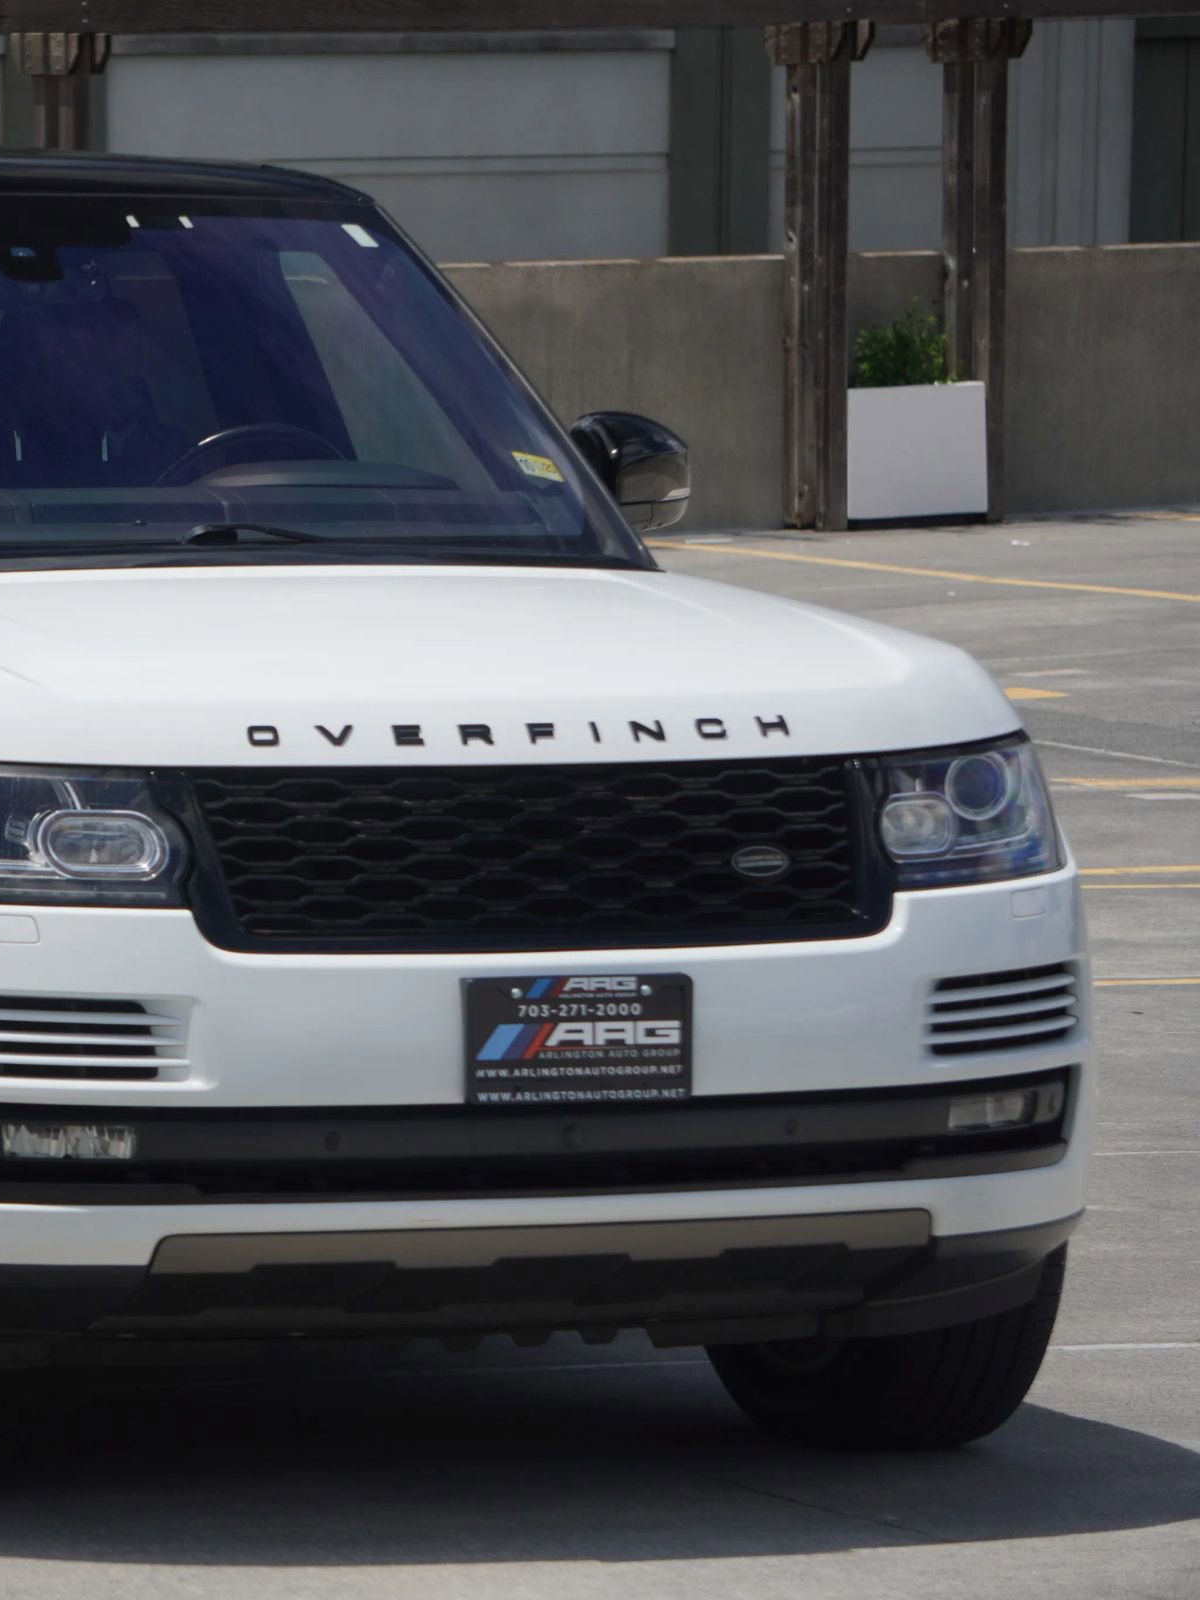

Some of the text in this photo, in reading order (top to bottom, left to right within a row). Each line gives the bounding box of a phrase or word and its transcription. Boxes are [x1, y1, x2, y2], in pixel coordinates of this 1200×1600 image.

[246, 715, 791, 748] OVERFINCH
[562, 976, 638, 991] AAG
[517, 1002, 642, 1018] 703-271-2000
[544, 1020, 681, 1047] AAG
[538, 1048, 681, 1059] ARLINGTON AUTO GROUP
[475, 1064, 683, 1078] WWW.ARLINGTONAUTOGROUP.NET
[477, 1088, 685, 1102] WWW.ARLINGTONAUTOGROUP.NET
